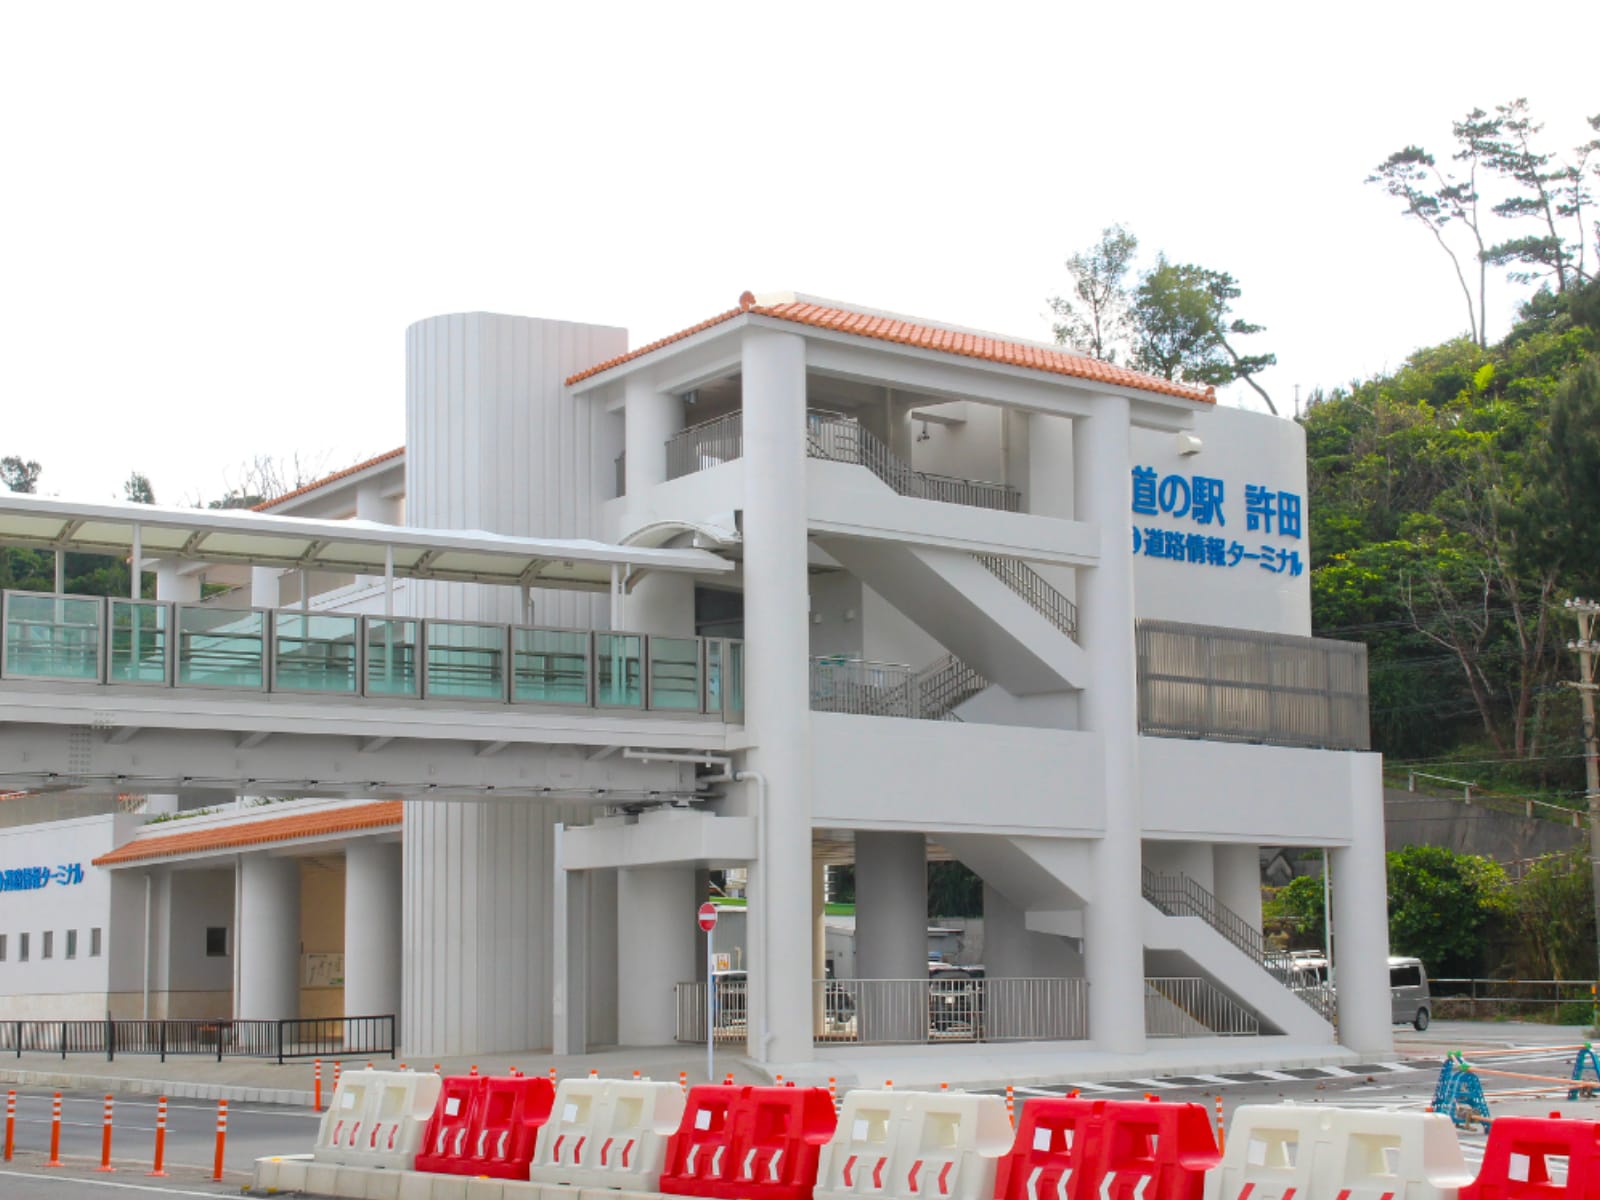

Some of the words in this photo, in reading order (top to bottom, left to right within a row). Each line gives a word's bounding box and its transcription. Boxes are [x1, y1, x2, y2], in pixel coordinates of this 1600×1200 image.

[1131, 464, 1226, 527] 道の駅
[1245, 483, 1303, 540] 許田
